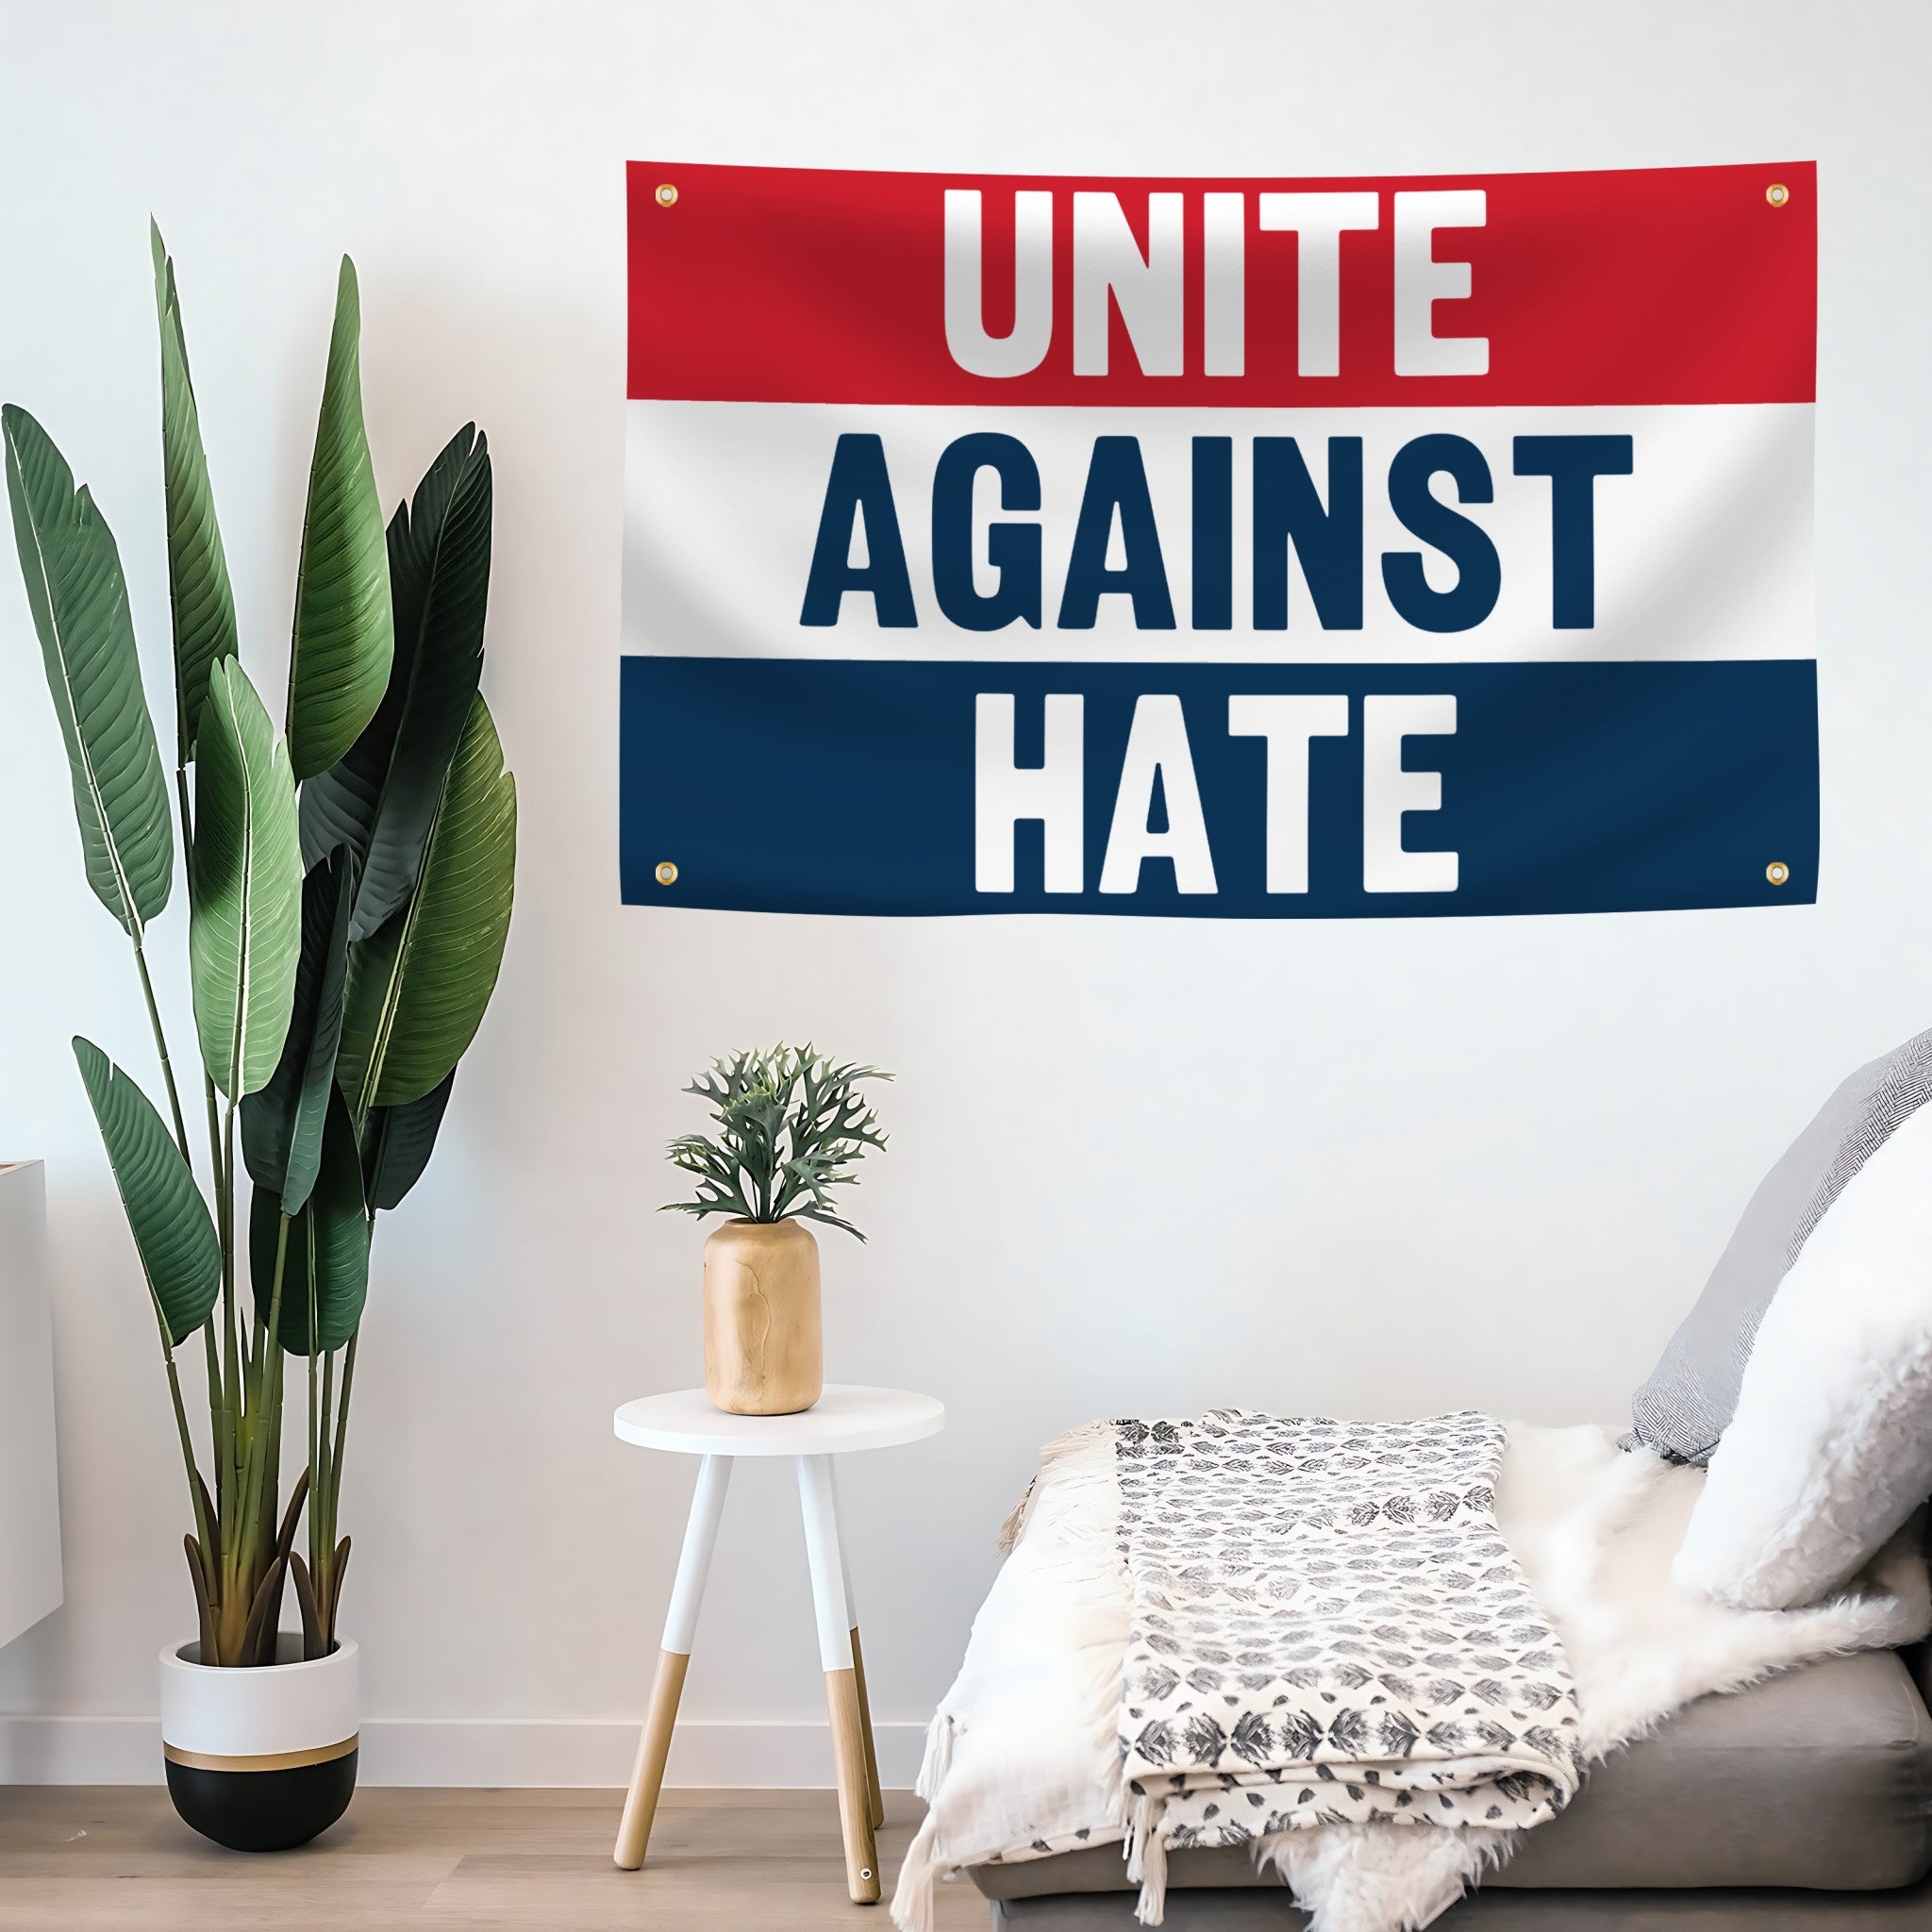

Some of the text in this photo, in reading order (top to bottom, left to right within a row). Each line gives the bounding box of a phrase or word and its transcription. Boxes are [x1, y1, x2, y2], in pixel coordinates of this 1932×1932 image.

[943, 189, 1490, 378] UNITE
[800, 432, 1634, 633] AGAINST
[974, 692, 1459, 894] HATE
